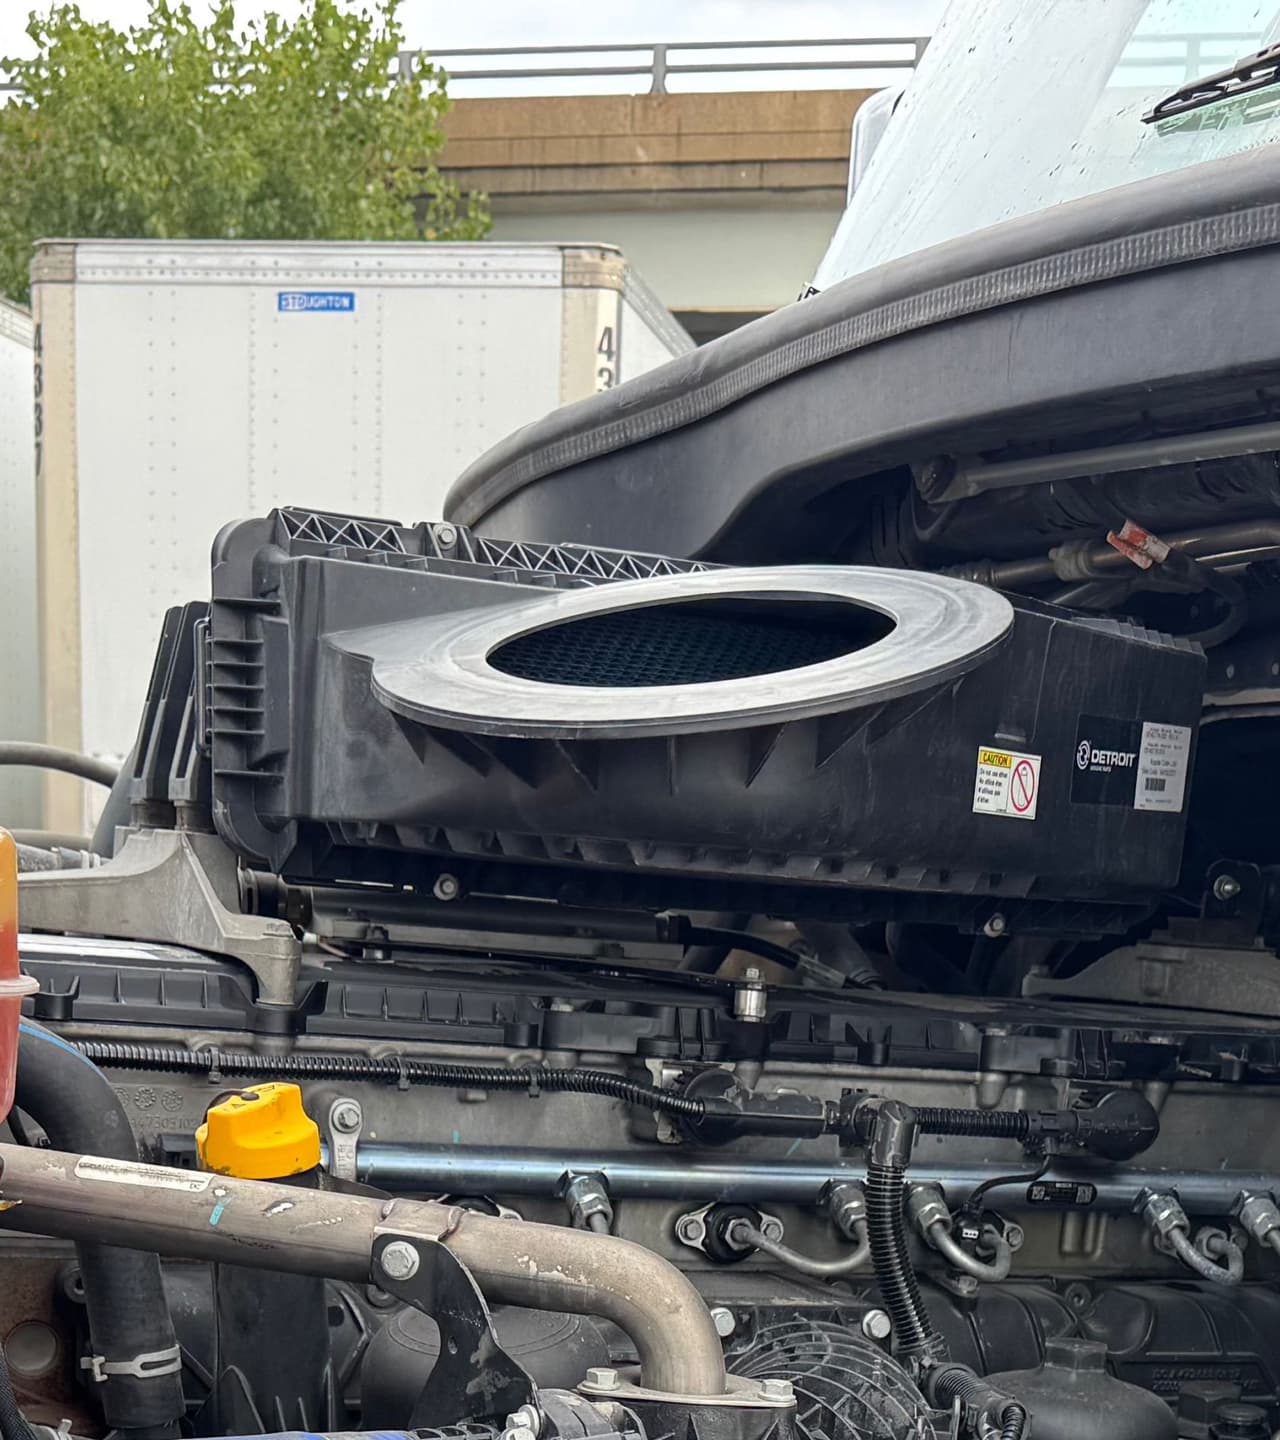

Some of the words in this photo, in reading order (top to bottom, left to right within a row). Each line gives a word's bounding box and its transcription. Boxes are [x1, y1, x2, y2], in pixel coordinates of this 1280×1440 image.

[281, 294, 351, 309] STOUGHTON
[982, 753, 1009, 766] CAUTION
[1090, 749, 1136, 767] DETROIT
